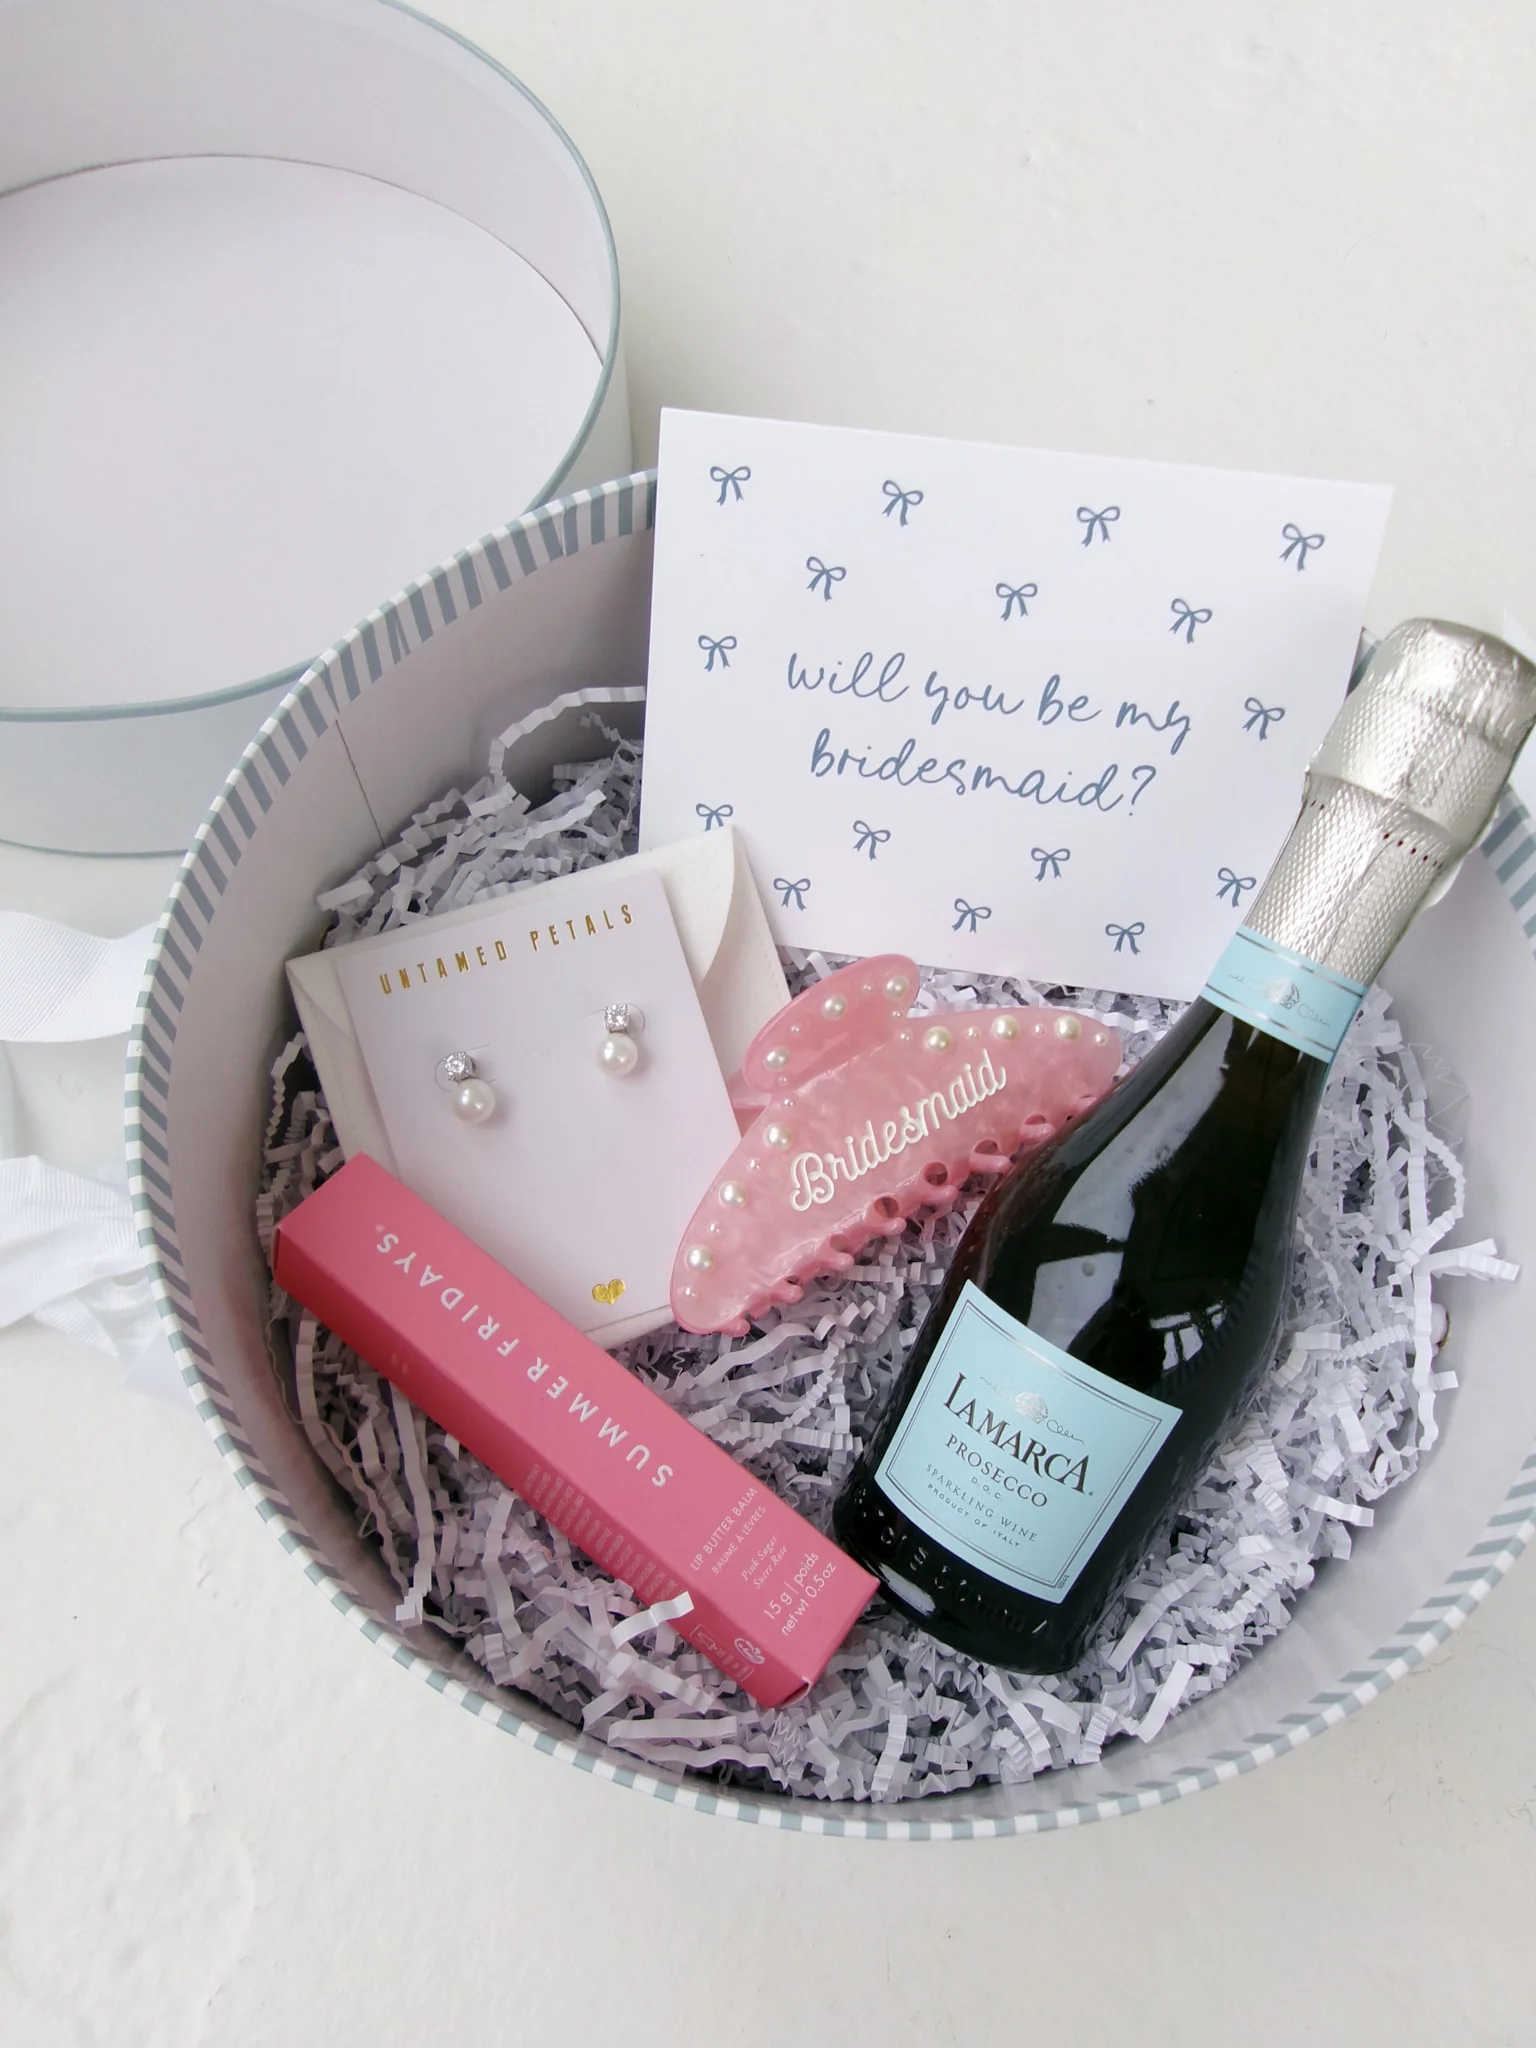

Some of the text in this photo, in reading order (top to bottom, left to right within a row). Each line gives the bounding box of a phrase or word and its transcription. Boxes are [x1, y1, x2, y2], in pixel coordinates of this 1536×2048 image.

[788, 652, 1191, 755] will you be my
[810, 728, 1157, 816] bridesmaid?
[379, 904, 633, 995] UNTAMED PETALS
[790, 1048, 1007, 1212] Bridesmaid
[526, 1356, 674, 1488] SUMMER
[925, 1463, 994, 1518] SPARKLING
[1000, 1516, 1038, 1542] WINE
[945, 1432, 1048, 1508] PROSECCO
[690, 1487, 759, 1572] LIP BUTTER BALM
[927, 1483, 1020, 1548] PRODUCT OF ITALY
[711, 1542, 739, 1575] BAUME
[741, 1534, 779, 1582] Pink Sugar
[753, 1565, 774, 1590] Sucre
[763, 1599, 783, 1620] 15
[780, 1590, 793, 1605] g
[793, 1551, 820, 1587] poids
